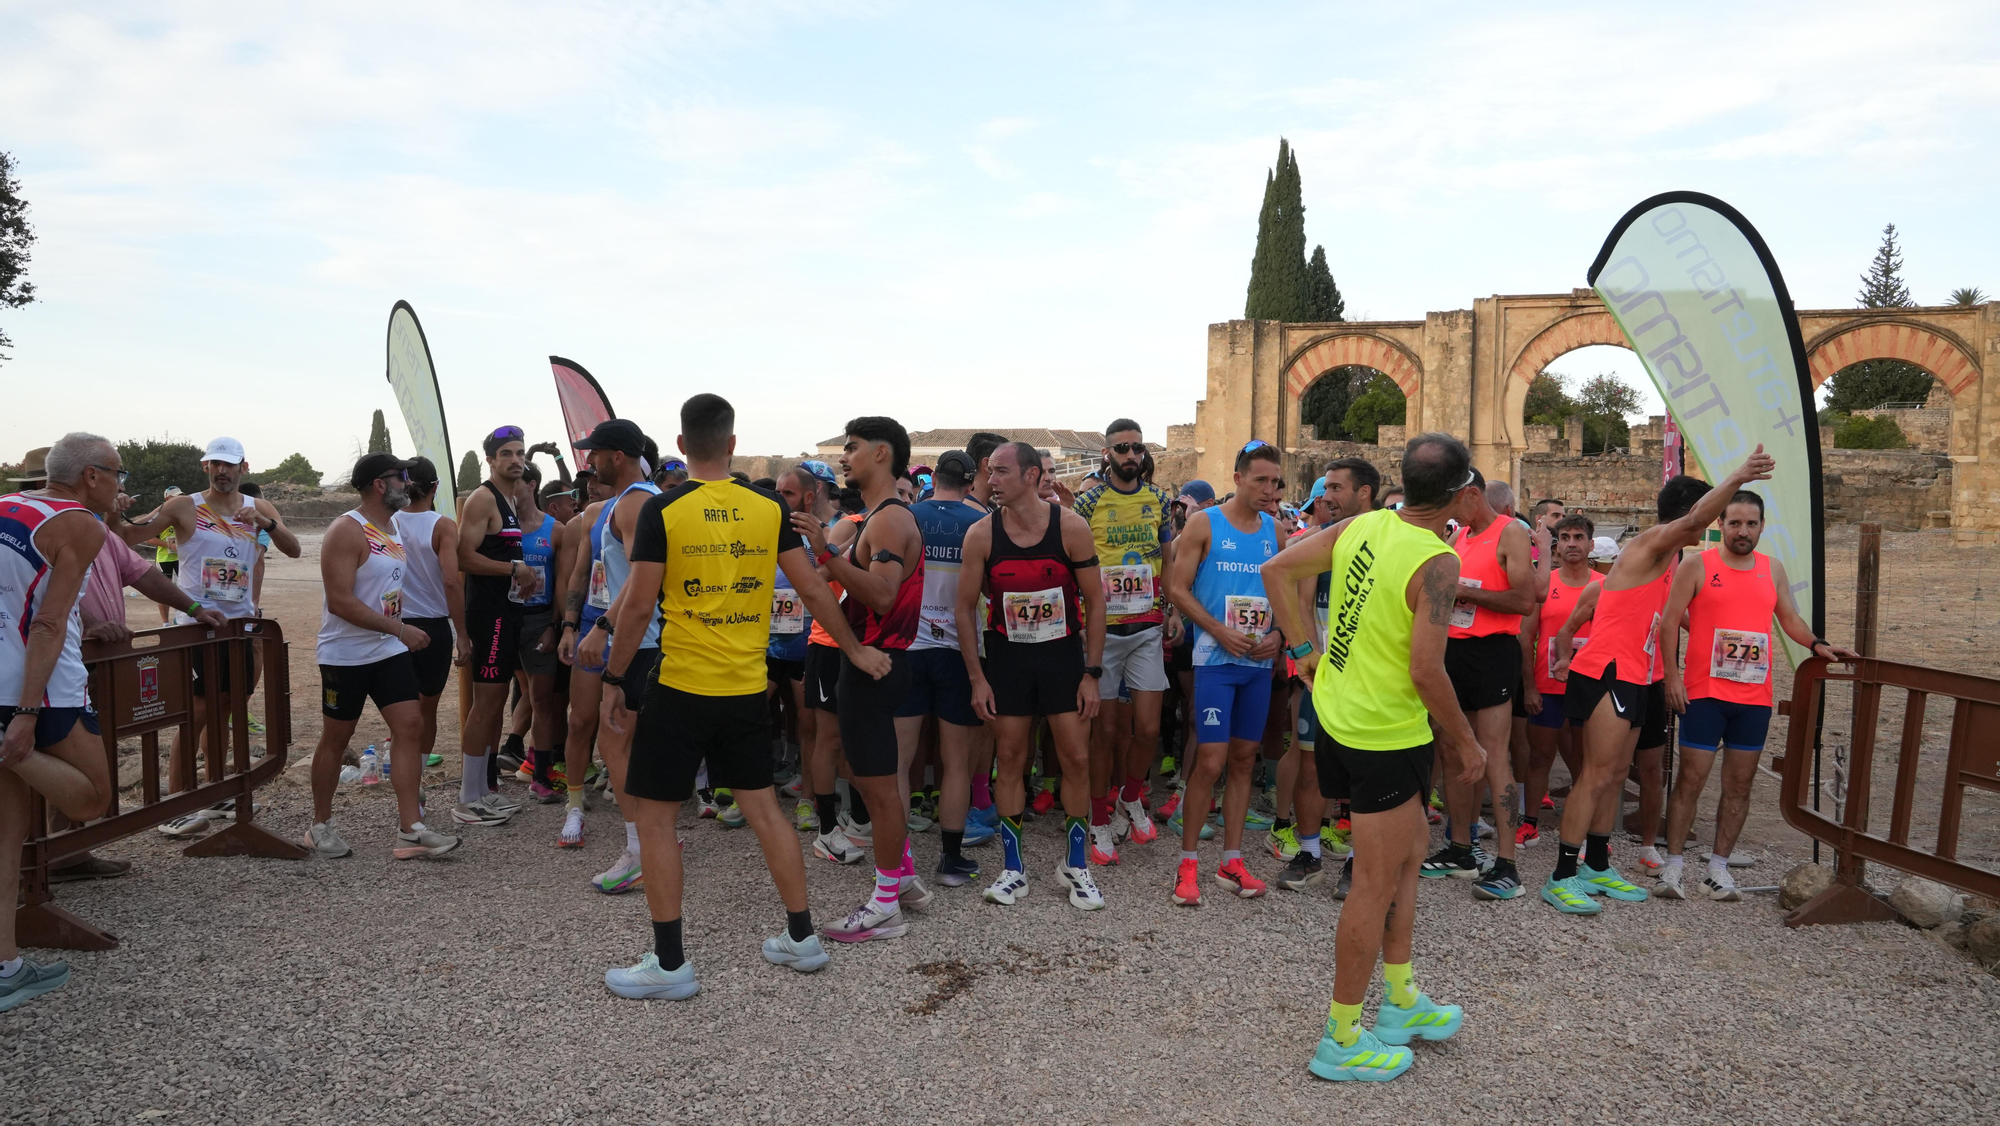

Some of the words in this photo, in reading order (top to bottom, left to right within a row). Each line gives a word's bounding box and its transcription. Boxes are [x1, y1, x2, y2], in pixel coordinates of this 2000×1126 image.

[704, 508, 728, 522] RAFA
[733, 508, 744, 521] C.
[1106, 525, 1142, 534] CANILLAS
[1106, 532, 1154, 543] ALBAIDA
[682, 545, 707, 554] ICONO
[710, 544, 727, 553] DIEZ
[218, 568, 238, 582] 32
[690, 585, 728, 593] SALDENT
[1112, 577, 1142, 593] 301
[1018, 603, 1053, 621] 478
[1239, 609, 1266, 626] 537
[1726, 643, 1760, 661] 273
